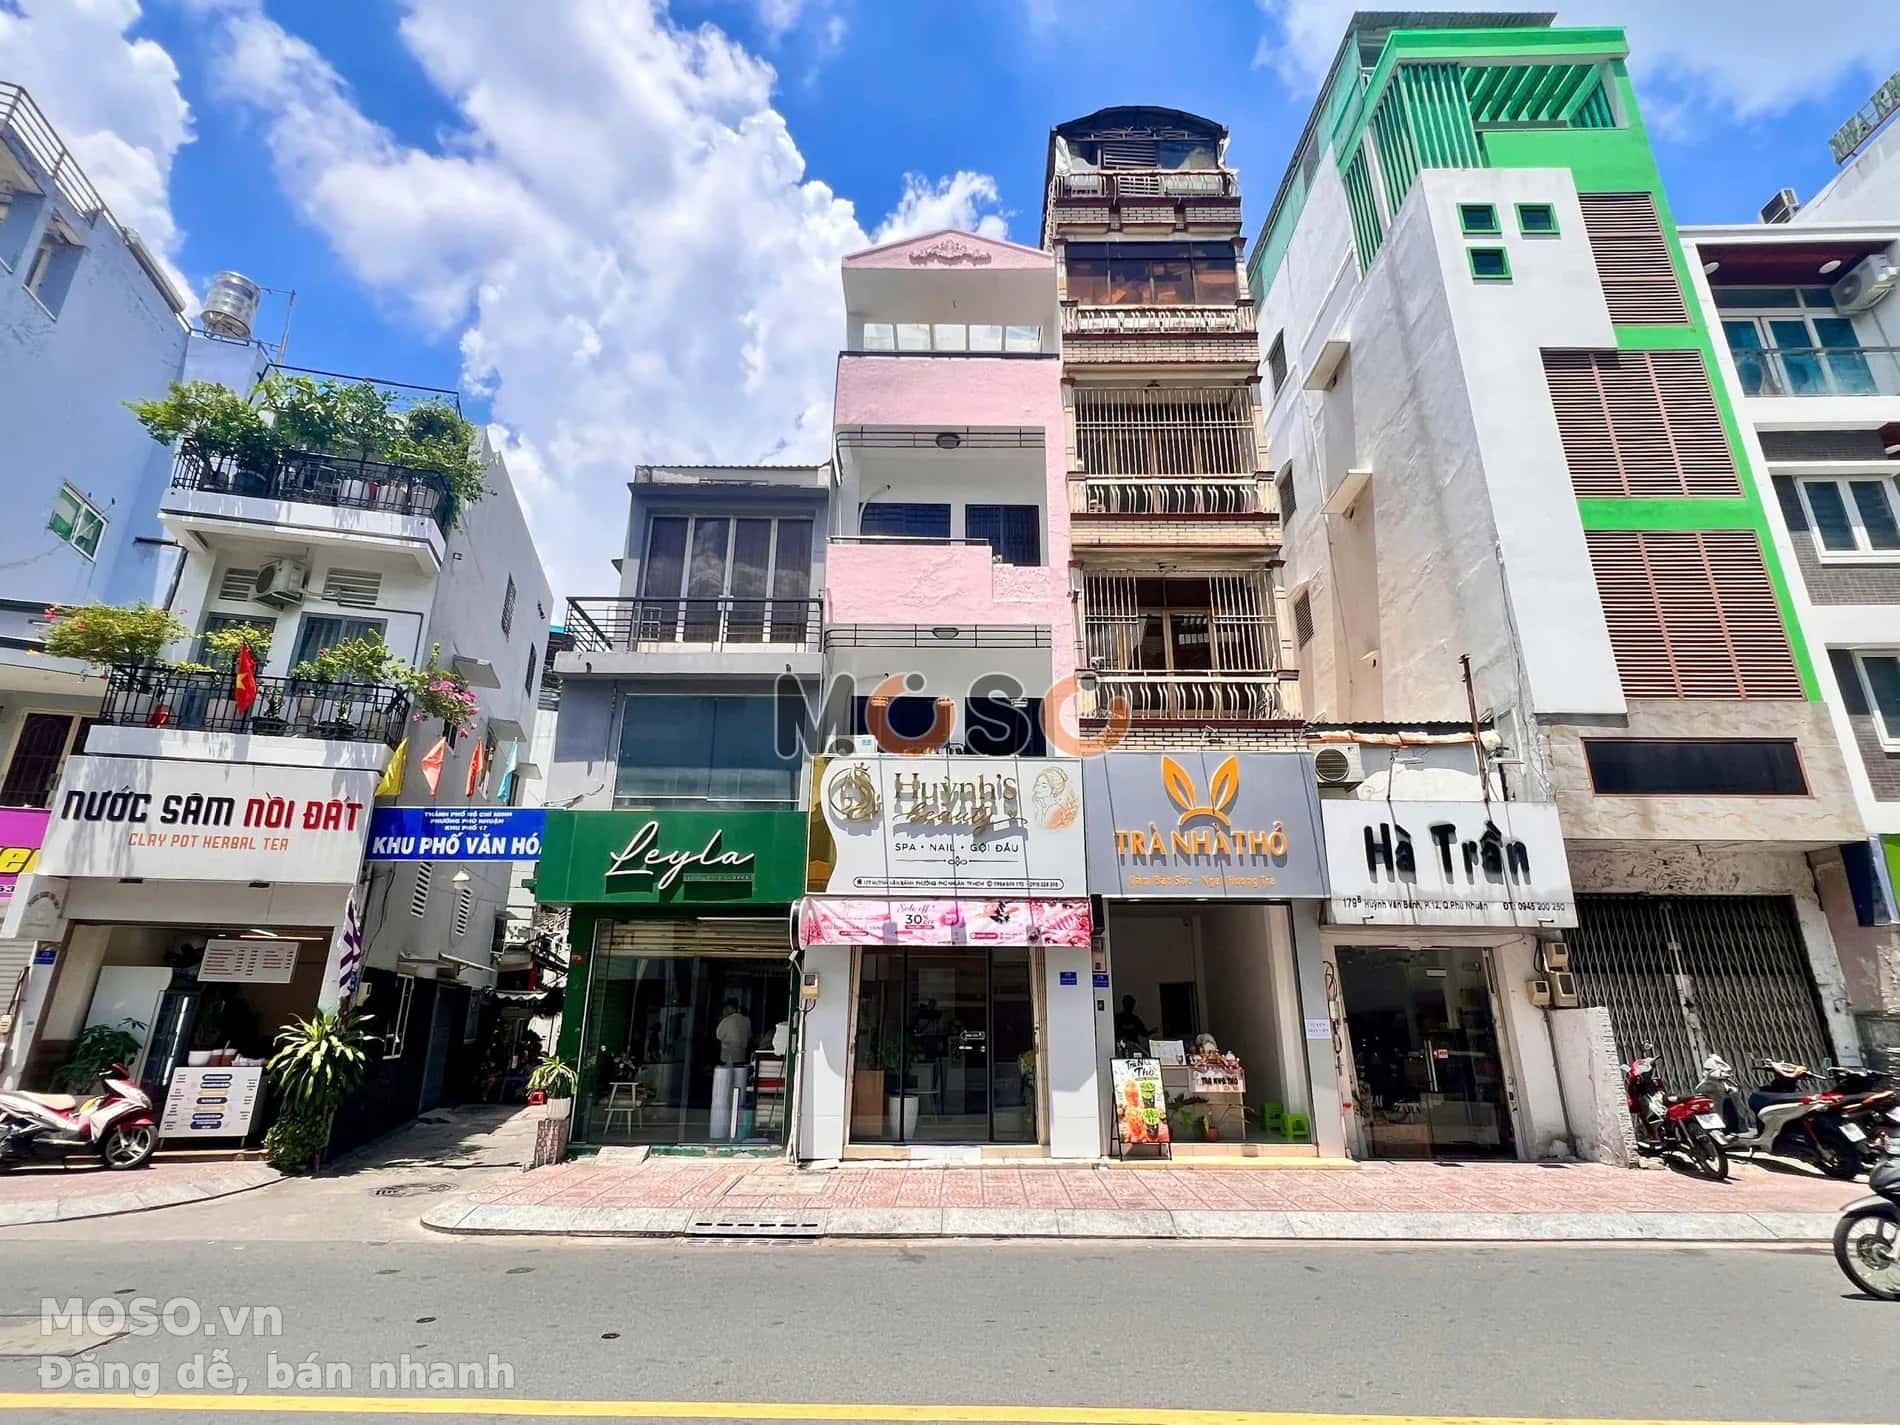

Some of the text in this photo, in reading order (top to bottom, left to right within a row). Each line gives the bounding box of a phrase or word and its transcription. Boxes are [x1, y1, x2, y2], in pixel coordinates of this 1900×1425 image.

[61, 785, 151, 823] NƯỚC
[160, 793, 235, 826] SÂM
[128, 832, 288, 851] CLAY POT HERBAL TEA
[372, 832, 542, 856] KHU PHỐ VĂN HÓ
[605, 821, 755, 889] Leyla
[895, 843, 916, 852] SPA
[930, 844, 955, 852] NAIL
[1115, 820, 1288, 856] TRÀ NHÀ THỎ
[1364, 823, 1416, 880] Hà
